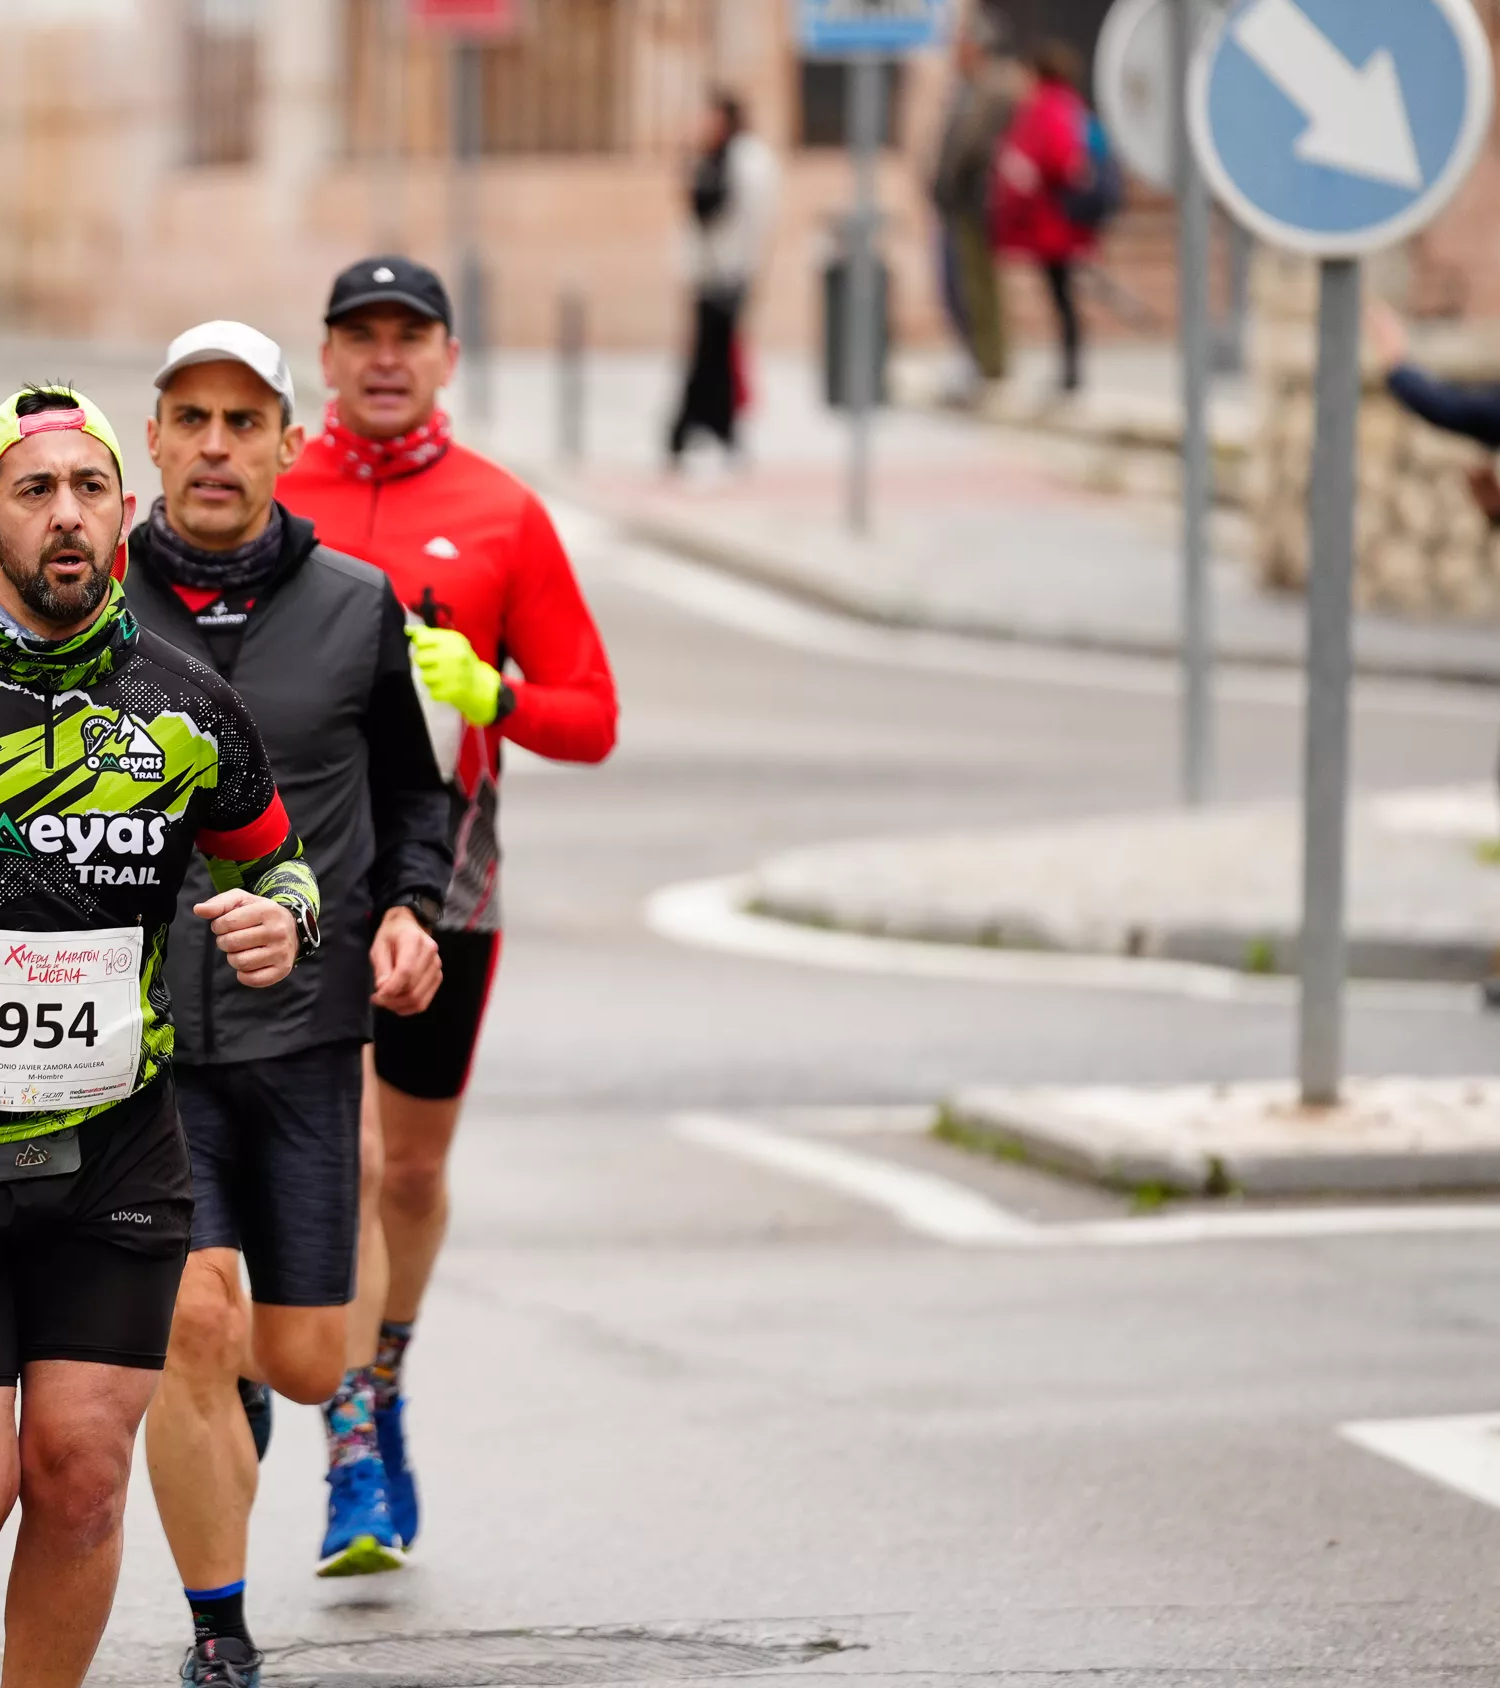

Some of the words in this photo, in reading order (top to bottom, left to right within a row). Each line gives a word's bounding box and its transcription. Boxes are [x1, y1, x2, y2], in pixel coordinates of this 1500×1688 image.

[133, 771, 163, 780] TRAIL
[74, 865, 161, 886] TRAIL
[27, 965, 88, 984] LUCENA
[18, 1062, 42, 1071] JAVIER
[42, 1062, 73, 1071] ZAMORA
[73, 1060, 105, 1070] AGUILERA
